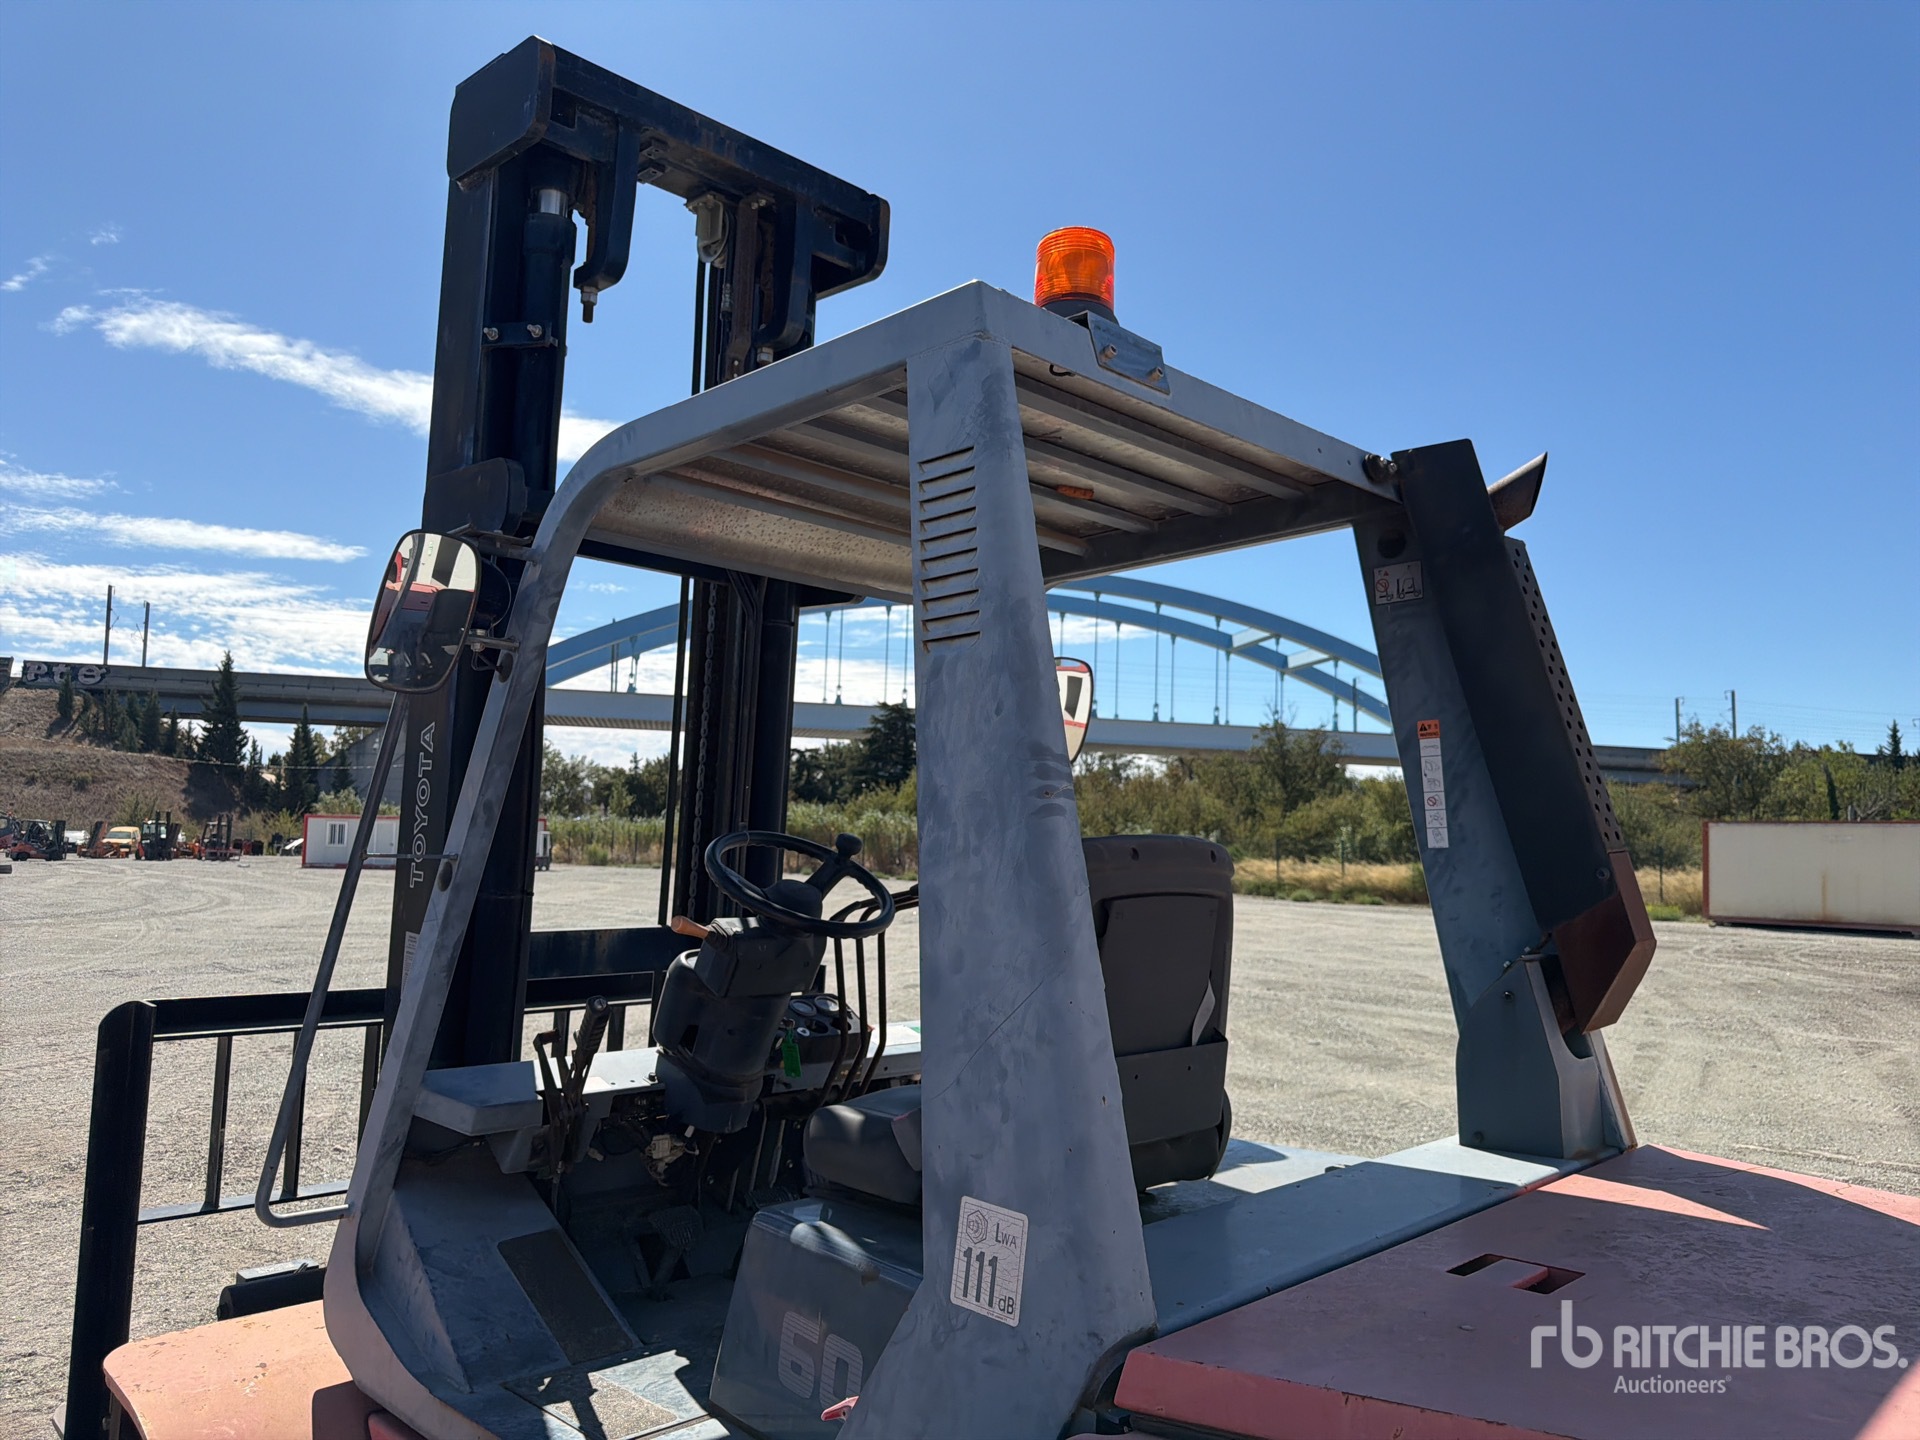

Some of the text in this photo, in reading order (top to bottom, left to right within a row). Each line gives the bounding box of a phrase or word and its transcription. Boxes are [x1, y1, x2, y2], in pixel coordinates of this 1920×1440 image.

[410, 722, 435, 888] TOYOTA
[963, 1247, 998, 1308] 111
[998, 1296, 1014, 1315] dB
[778, 1311, 863, 1409] 60
